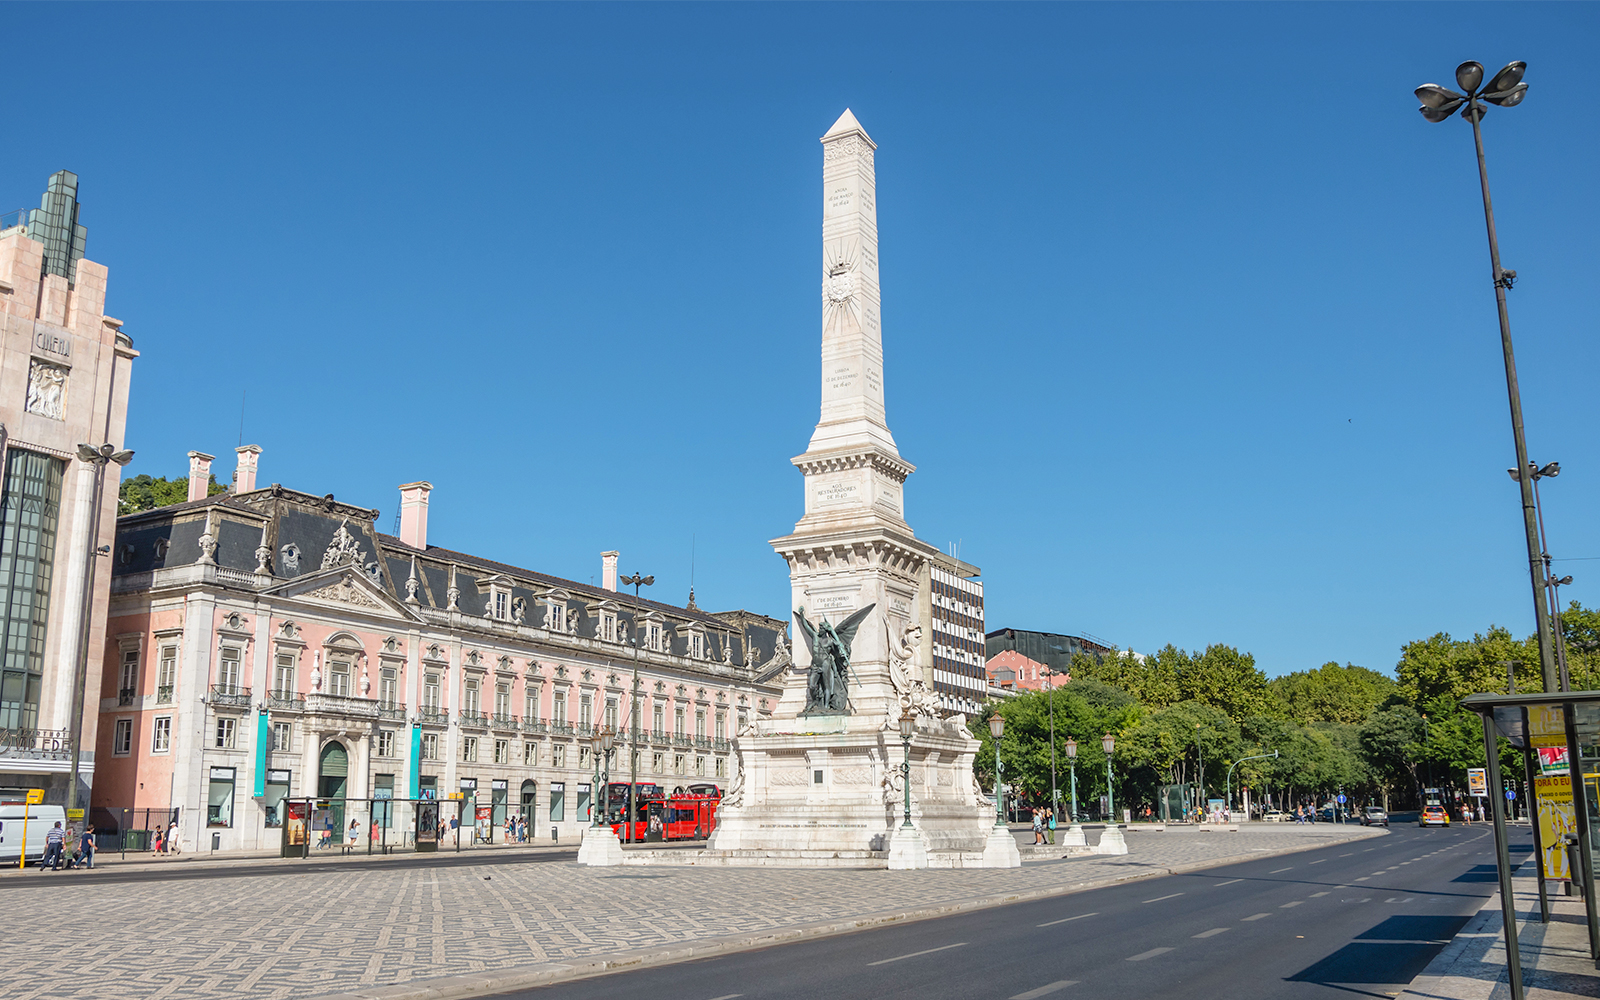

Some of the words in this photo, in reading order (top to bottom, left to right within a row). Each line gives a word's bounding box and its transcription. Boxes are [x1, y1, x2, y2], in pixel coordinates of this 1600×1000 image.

[36, 332, 70, 357] CINEMA
[817, 486, 857, 496] RESTAURADORES
[42, 738, 72, 752] EDE
[1534, 779, 1552, 787] FORA
